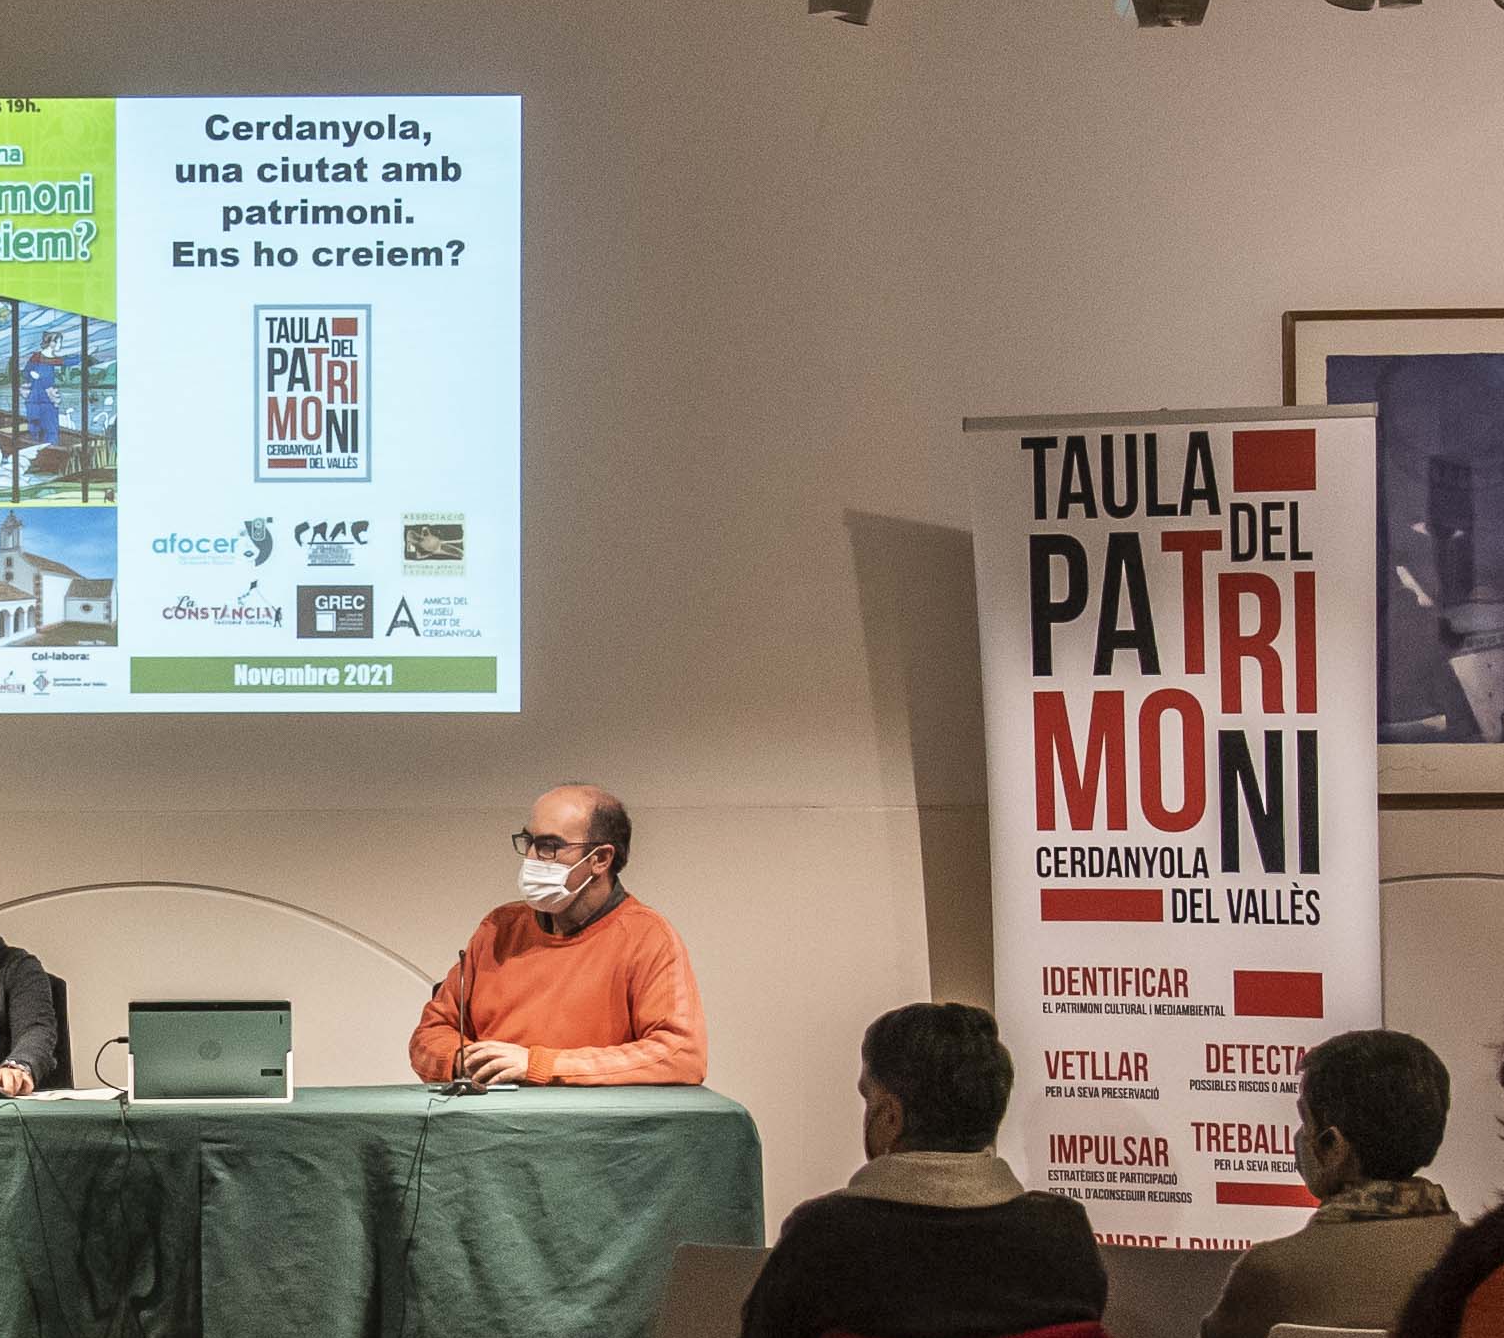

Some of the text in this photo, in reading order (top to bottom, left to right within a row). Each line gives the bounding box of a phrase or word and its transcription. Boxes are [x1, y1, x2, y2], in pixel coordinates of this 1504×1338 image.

[7, 99, 41, 113] 19h.
[204, 114, 432, 147] Cerdanyola,
[175, 156, 462, 183] una ciutat amb
[222, 198, 414, 231] patrimoni.
[172, 239, 465, 268] Ens ho creiem?
[265, 317, 329, 343] TAULA
[332, 339, 358, 357] DEL
[267, 444, 322, 456] CERDANYOLA
[309, 458, 325, 469] DEL
[1021, 431, 1222, 520] TAULA
[1230, 501, 1313, 562] DEL
[152, 533, 239, 554] afocer
[315, 595, 365, 610] GREC
[423, 597, 468, 606] AMICS DEL
[423, 608, 454, 617] MUSEU
[449, 618, 461, 627] DE
[423, 629, 482, 638] CERDANYOLA
[234, 664, 392, 686] Novembre 2021
[1036, 846, 1210, 879] CERDANYOLA
[1171, 882, 1321, 926] DEL VALLÈS
[1042, 966, 1189, 998] IDENTIFICAR
[1042, 1002, 1053, 1014] EL
[1056, 1002, 1103, 1014] PATRIMONI
[1104, 1003, 1147, 1015] CULTURAL
[1154, 1004, 1226, 1017] MEDIAMBIENTAL
[1045, 1050, 1149, 1082] VETLLAR
[1205, 1043, 1307, 1076] DETECTA
[1045, 1086, 1159, 1100] PER LA SEVA PRESERVACIÓ
[1189, 1079, 1299, 1094] POSSIBLES RISCOS O AME
[1190, 1122, 1295, 1155] TREBALL
[1049, 1134, 1169, 1167] IMPULSAR
[1214, 1159, 1231, 1171] PER
[1233, 1160, 1244, 1171] LA
[1246, 1160, 1269, 1172] SEVA
[1048, 1169, 1178, 1186] ESTRATÈGIES DE PARTICIPACIÓ
[1068, 1188, 1083, 1199] TAL
[1085, 1188, 1146, 1202] D'ACONSEGUIR
[1148, 1191, 1193, 1204] RECURSOS
